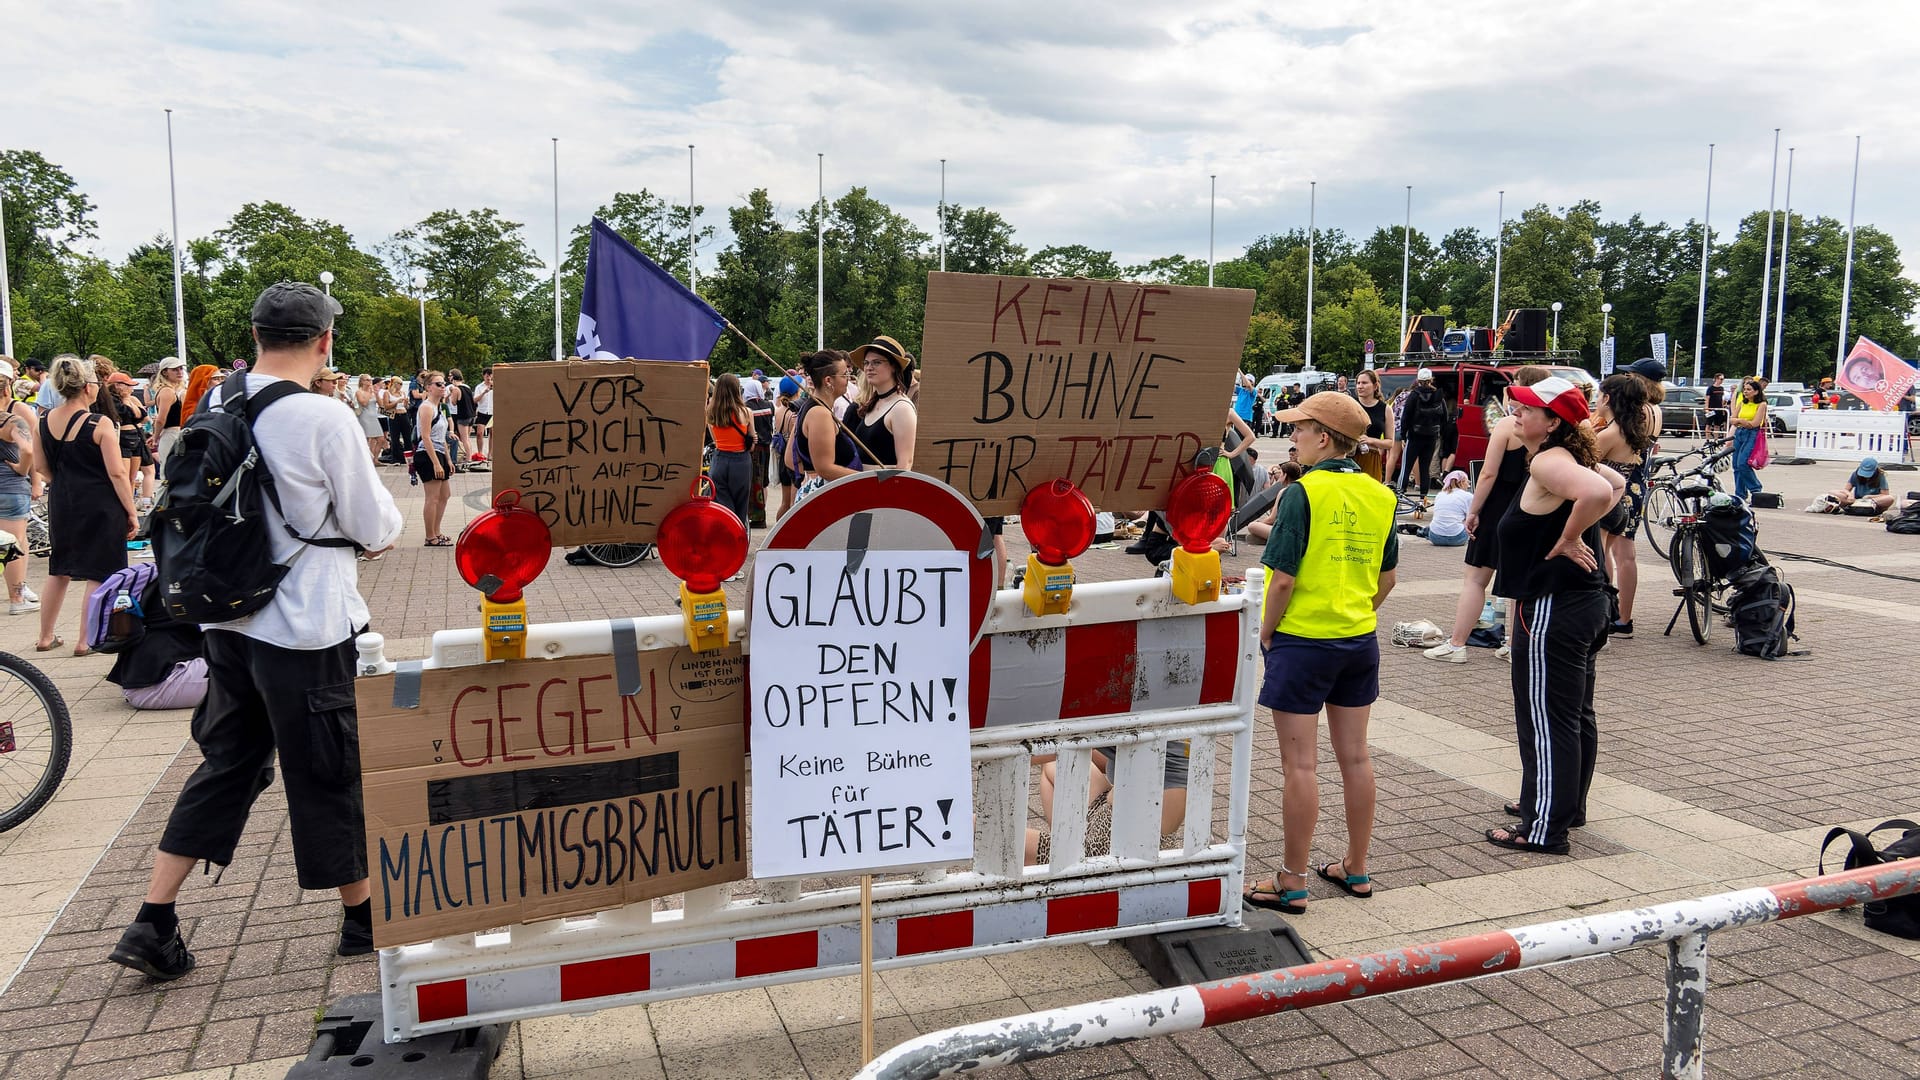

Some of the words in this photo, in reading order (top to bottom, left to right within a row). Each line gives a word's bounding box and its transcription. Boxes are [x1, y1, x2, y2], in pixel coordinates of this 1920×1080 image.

[992, 279, 1171, 346] KEINE
[553, 376, 653, 416] VOR
[967, 350, 1185, 424] BÜHNE
[511, 416, 682, 465] GERICHT
[520, 464, 580, 488] STATT
[592, 462, 637, 481] AUF
[636, 463, 692, 482] DIE
[932, 435, 1037, 501] FÜR
[1058, 432, 1202, 492] TÄTER
[519, 485, 665, 529] BÜHNE
[766, 563, 963, 628] GLAUBT
[681, 657, 743, 671] LINDEMANN
[694, 669, 711, 678] IST
[715, 667, 733, 676] EIN
[700, 648, 721, 658] TILL
[817, 641, 897, 675] DEN
[680, 675, 744, 690] HENSOHN
[764, 677, 958, 728] OPFERN!
[449, 668, 658, 768] GEGEN
[779, 753, 845, 778] Keine
[866, 750, 933, 773] Bühne
[831, 785, 870, 804] für
[787, 798, 954, 859] TÄTER!
[379, 781, 741, 922] MACHTMISSBRAUCH
